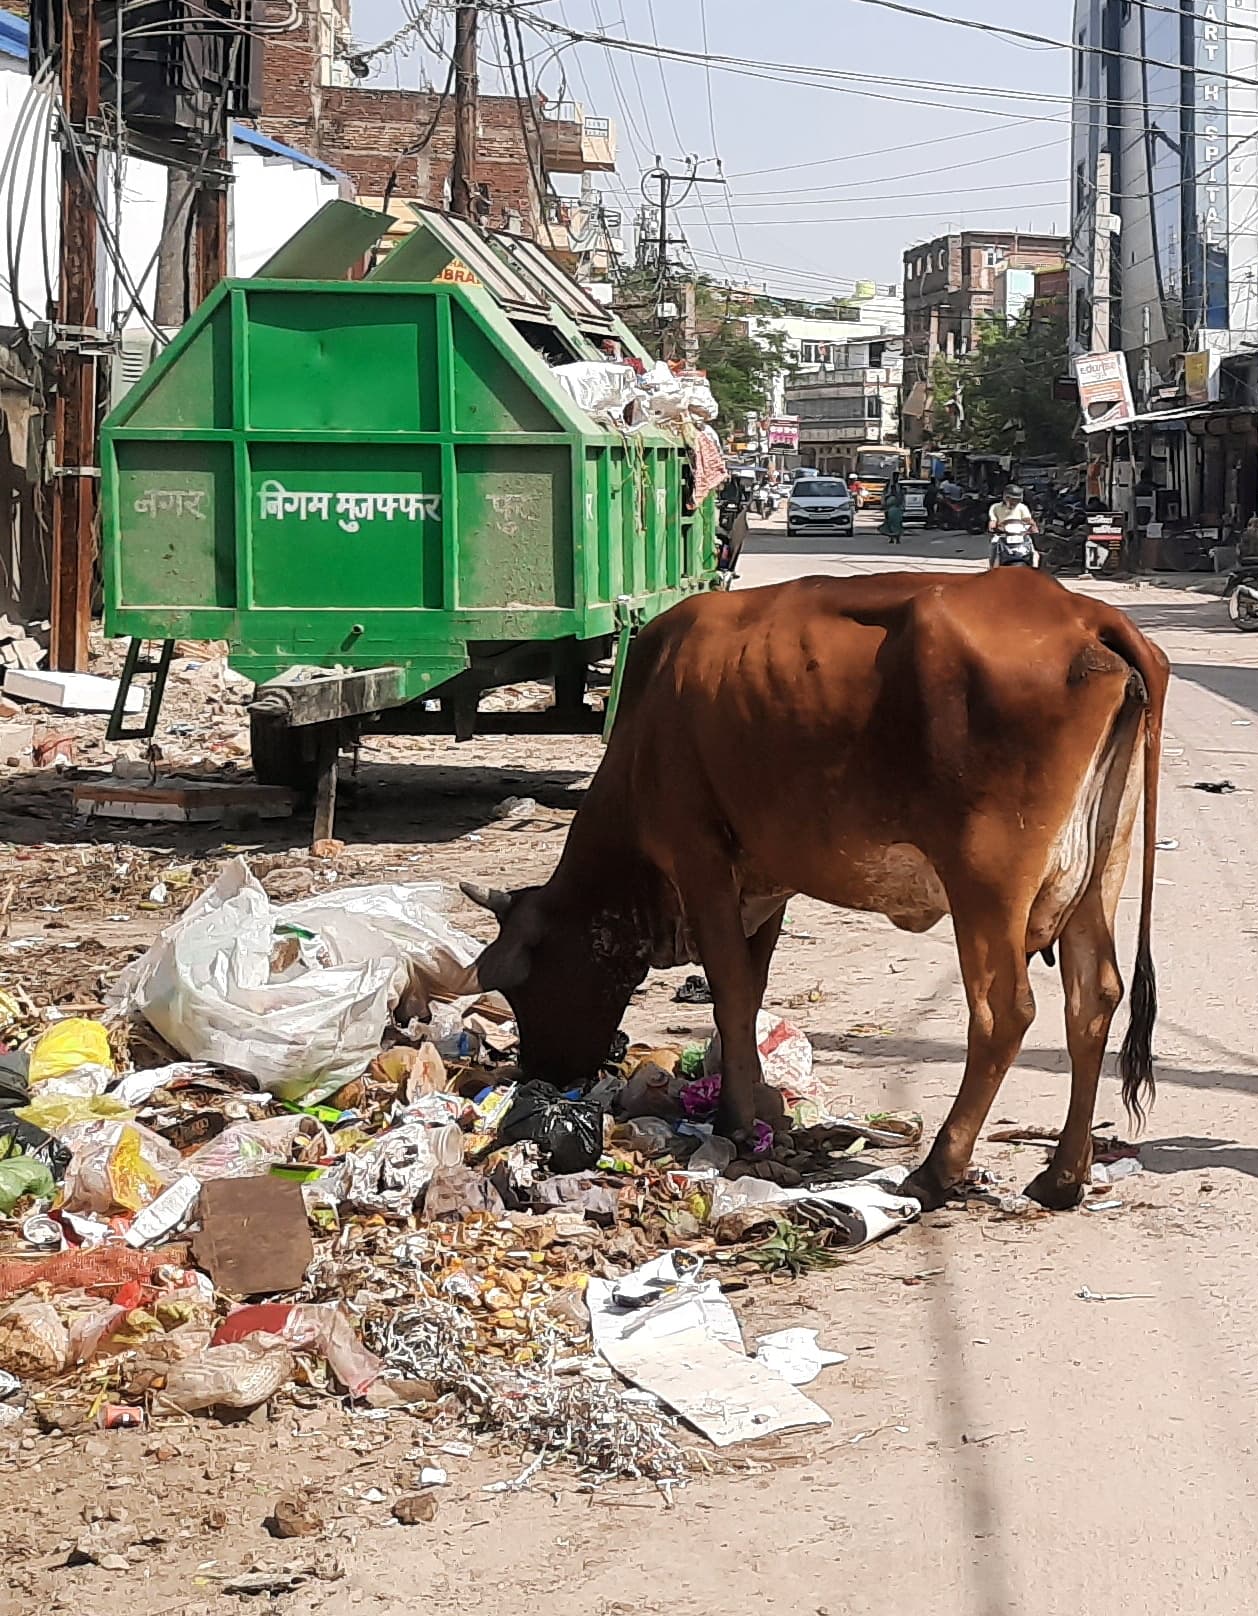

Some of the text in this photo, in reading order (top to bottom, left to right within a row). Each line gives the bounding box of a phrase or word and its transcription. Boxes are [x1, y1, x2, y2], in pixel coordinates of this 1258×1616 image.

[1203, 0, 1220, 245] ART HOSPITAL
[256, 479, 334, 521] निगम
